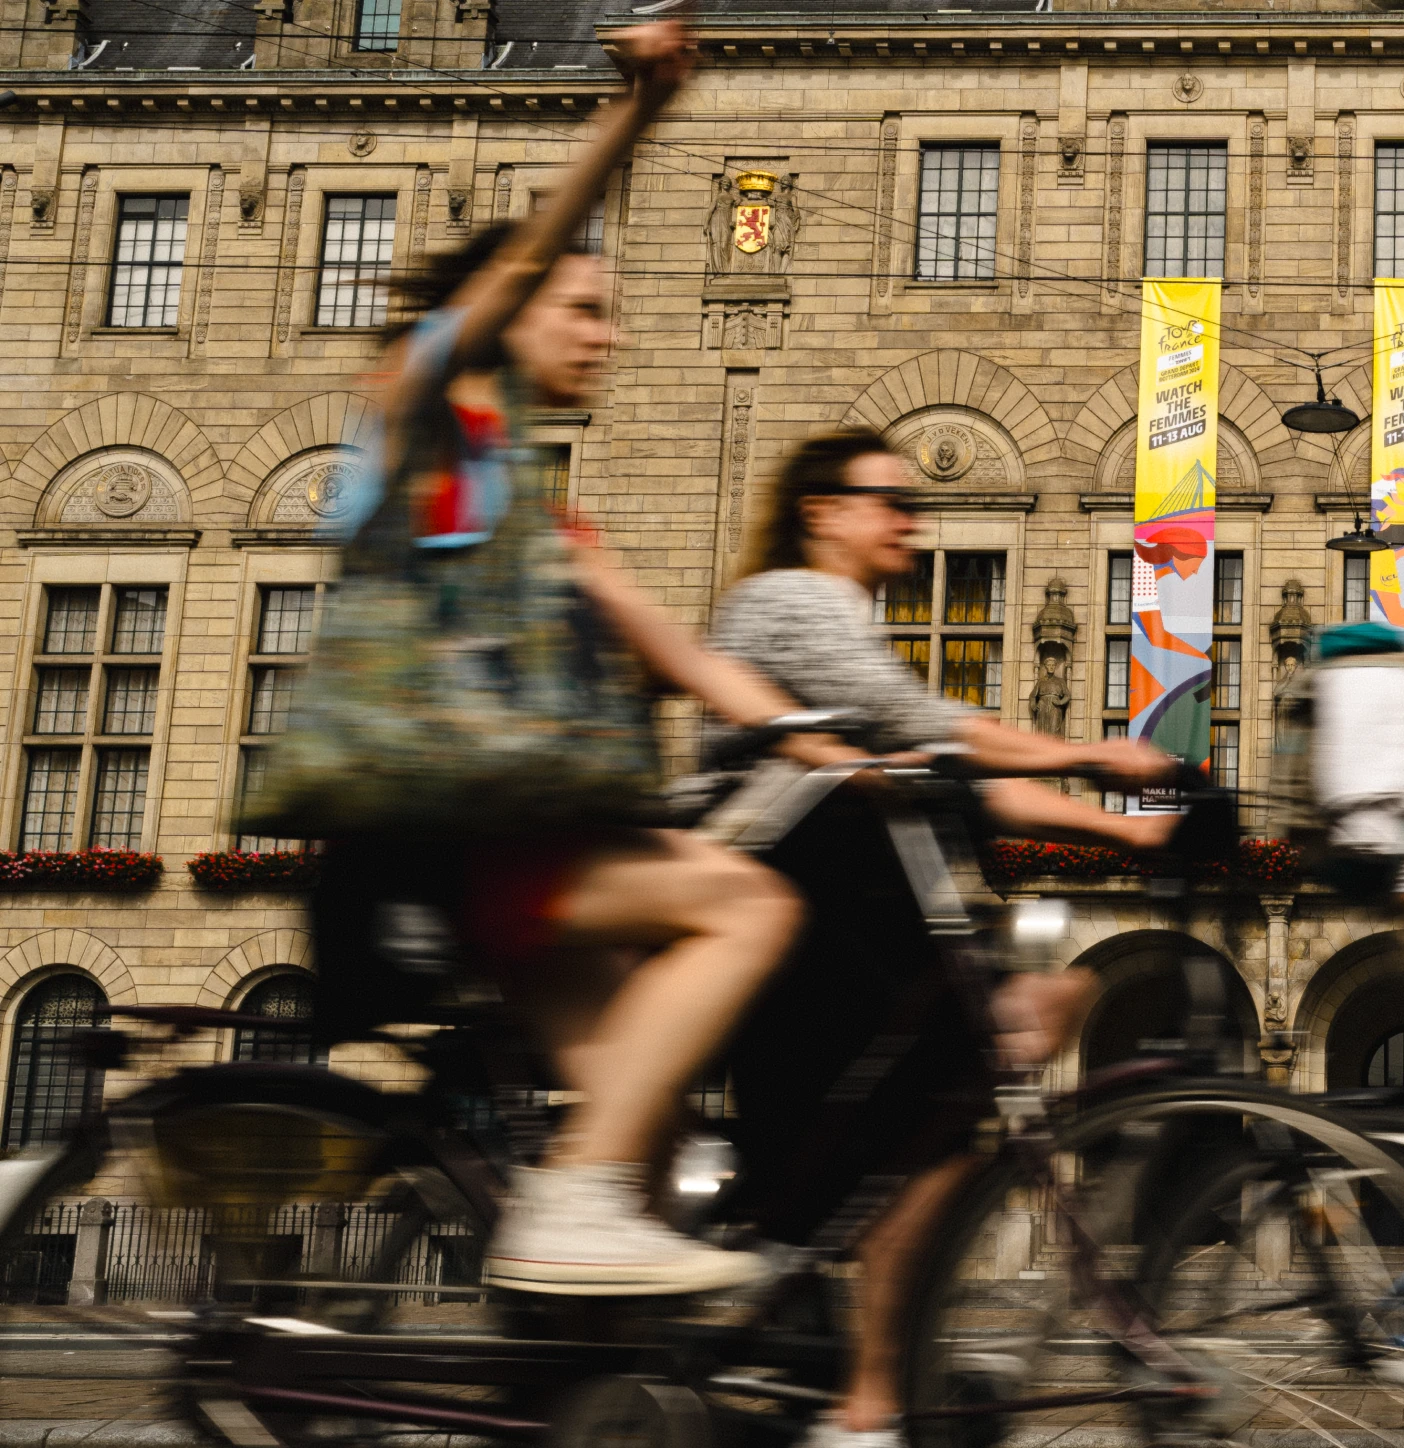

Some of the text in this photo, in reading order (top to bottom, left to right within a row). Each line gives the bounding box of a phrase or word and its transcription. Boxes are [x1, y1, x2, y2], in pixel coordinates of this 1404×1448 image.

[1156, 380, 1202, 404] WATCH
[1166, 396, 1192, 414] THE
[1149, 404, 1206, 432] FEMMES
[1152, 422, 1203, 448] 11-13 AUG
[101, 465, 126, 483] MUTUA
